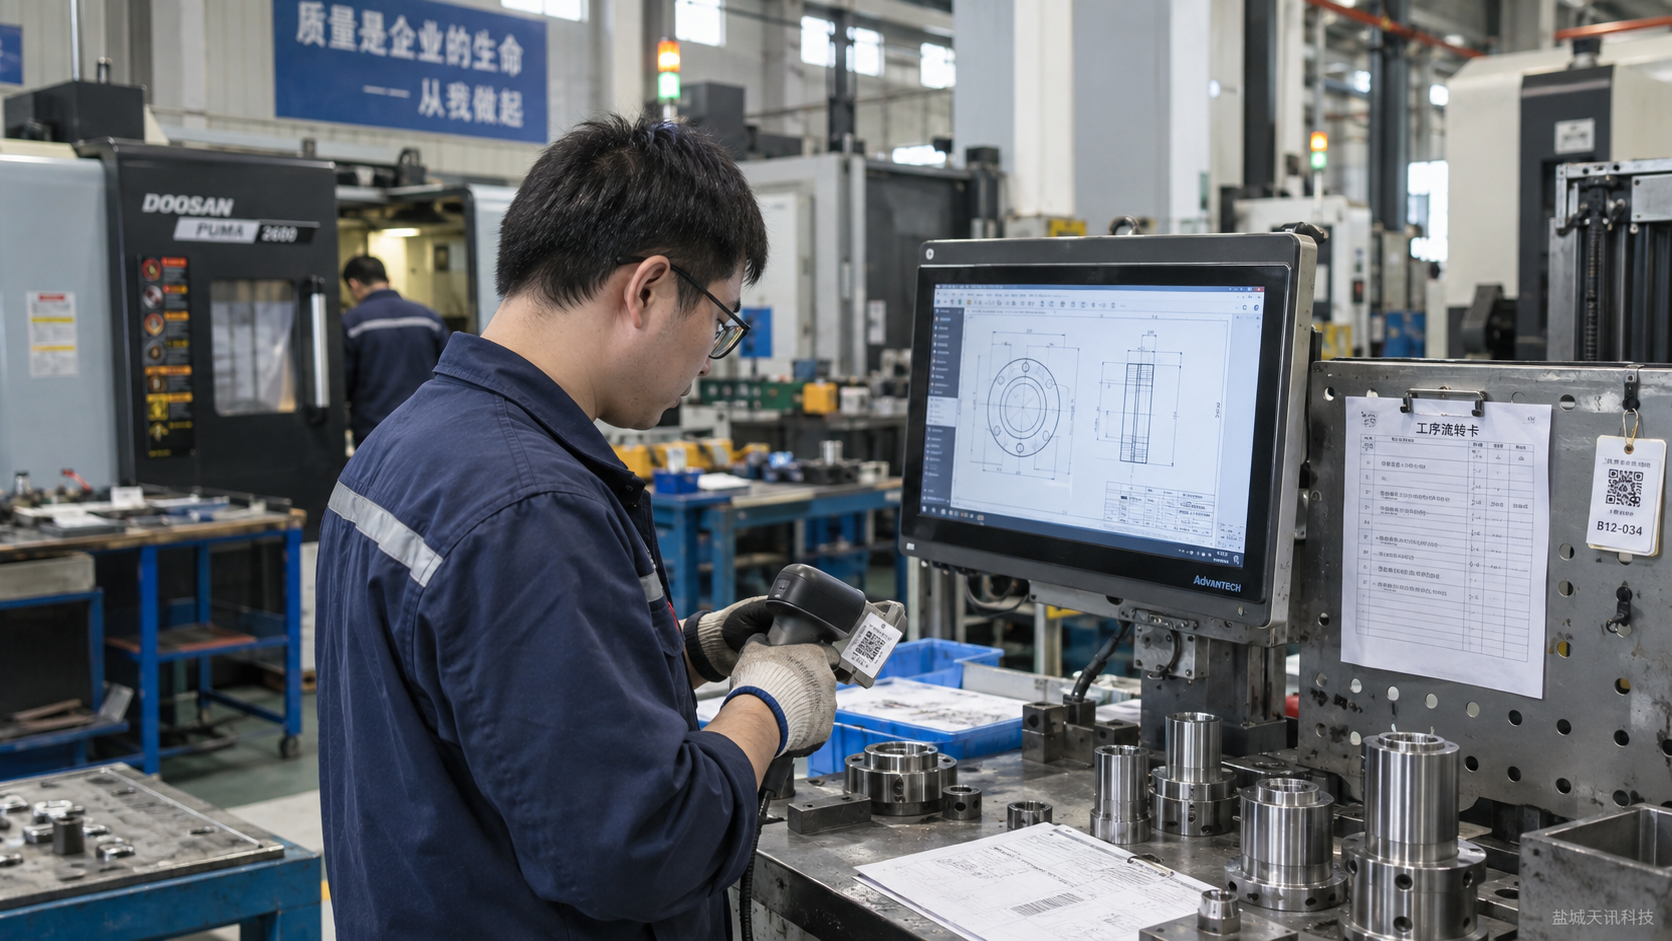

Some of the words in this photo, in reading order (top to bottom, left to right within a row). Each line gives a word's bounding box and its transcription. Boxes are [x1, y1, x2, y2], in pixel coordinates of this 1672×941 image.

[296, 1, 524, 77] 质量是企业的生命
[142, 193, 234, 217] DOOSAN
[196, 222, 244, 237] PUMA
[1416, 422, 1480, 438] 工序流转卡
[1596, 520, 1643, 536] B12-034
